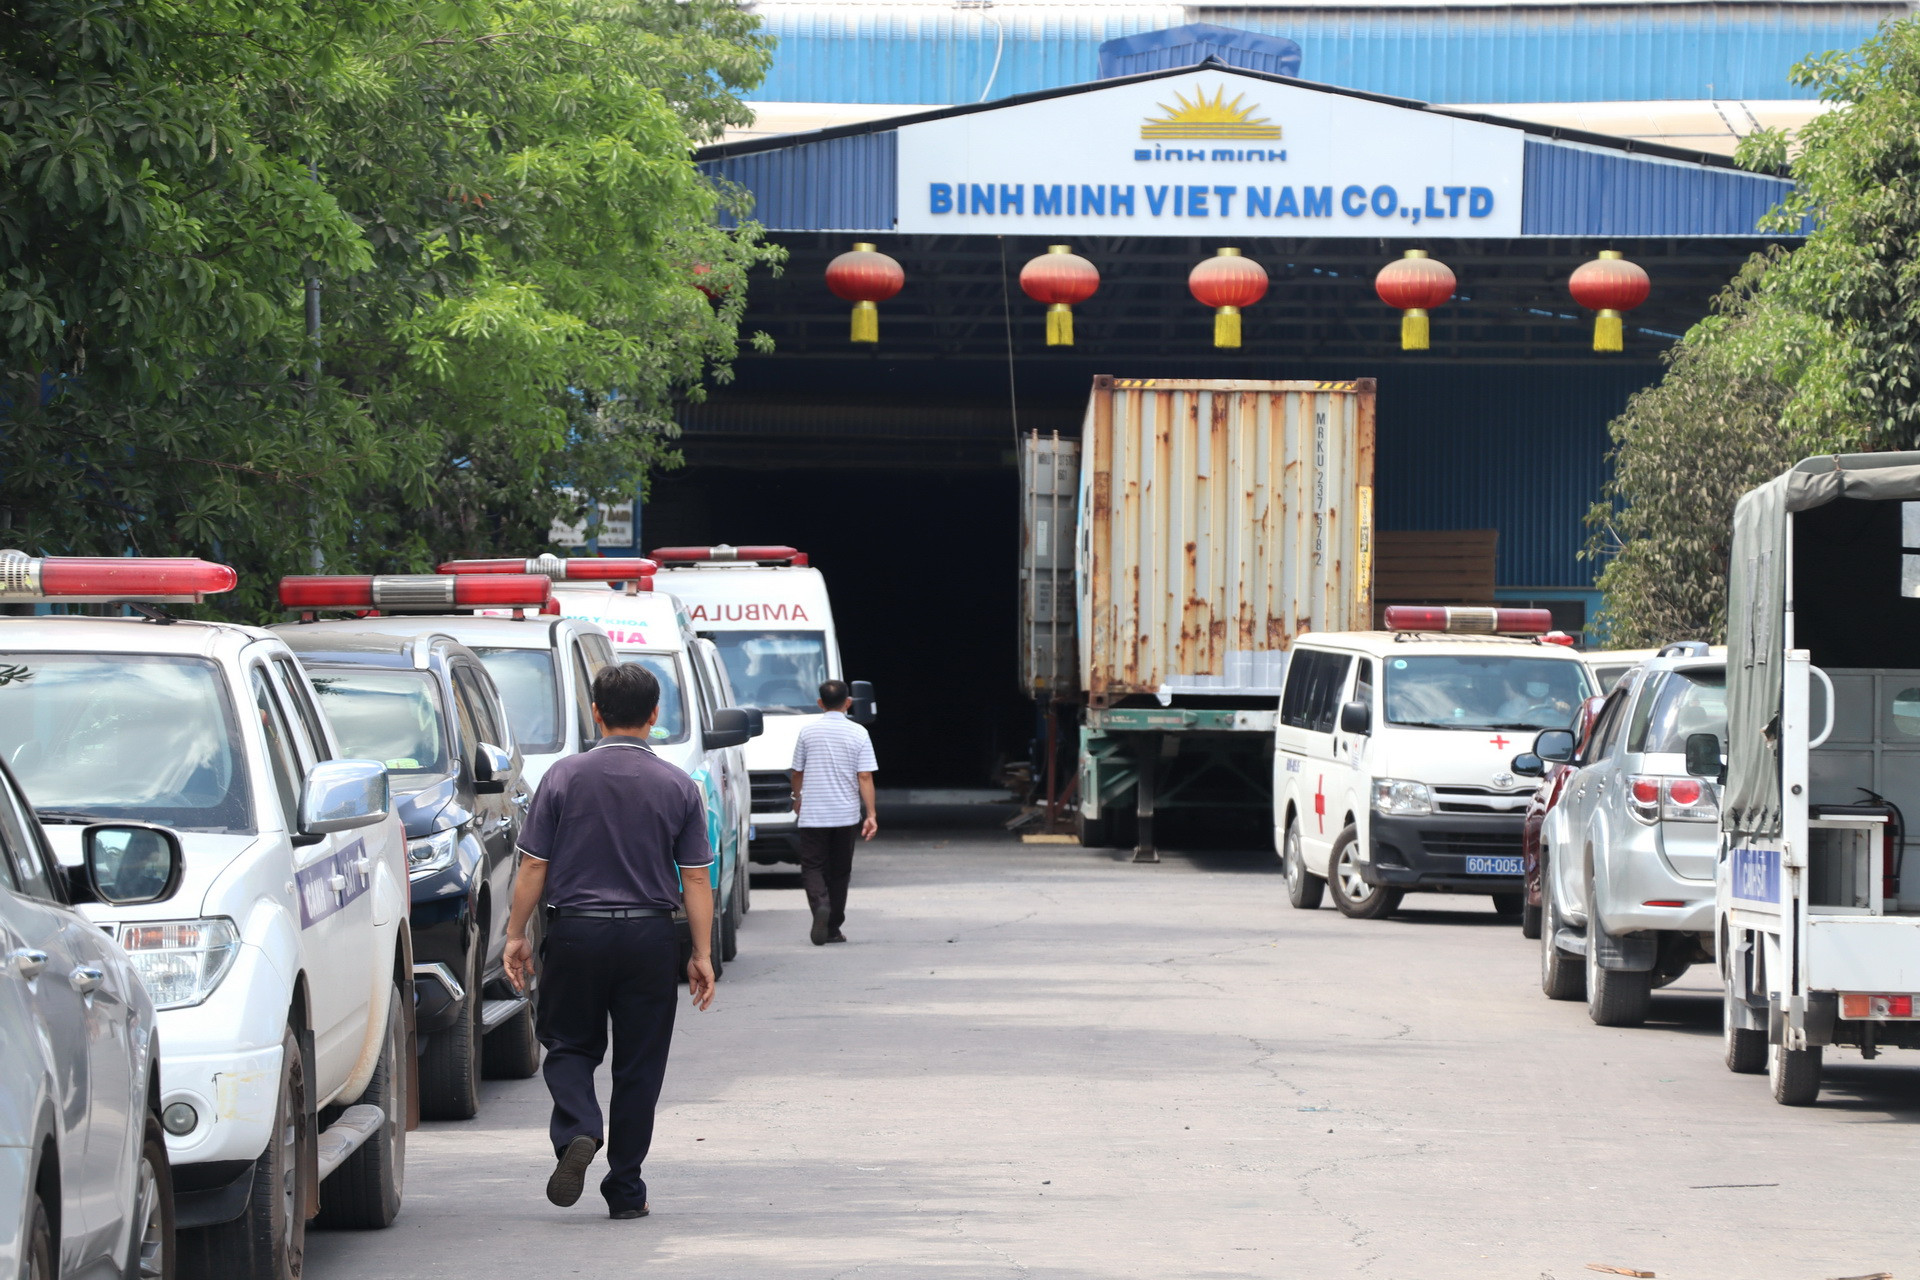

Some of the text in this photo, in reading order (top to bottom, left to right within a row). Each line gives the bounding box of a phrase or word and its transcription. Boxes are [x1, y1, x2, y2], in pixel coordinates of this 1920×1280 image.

[930, 182, 1024, 216] BINH
[1033, 184, 1135, 216] MINH
[1144, 184, 1237, 217] VIET
[1246, 185, 1333, 217] NAM
[1316, 412, 1326, 467] MRKU
